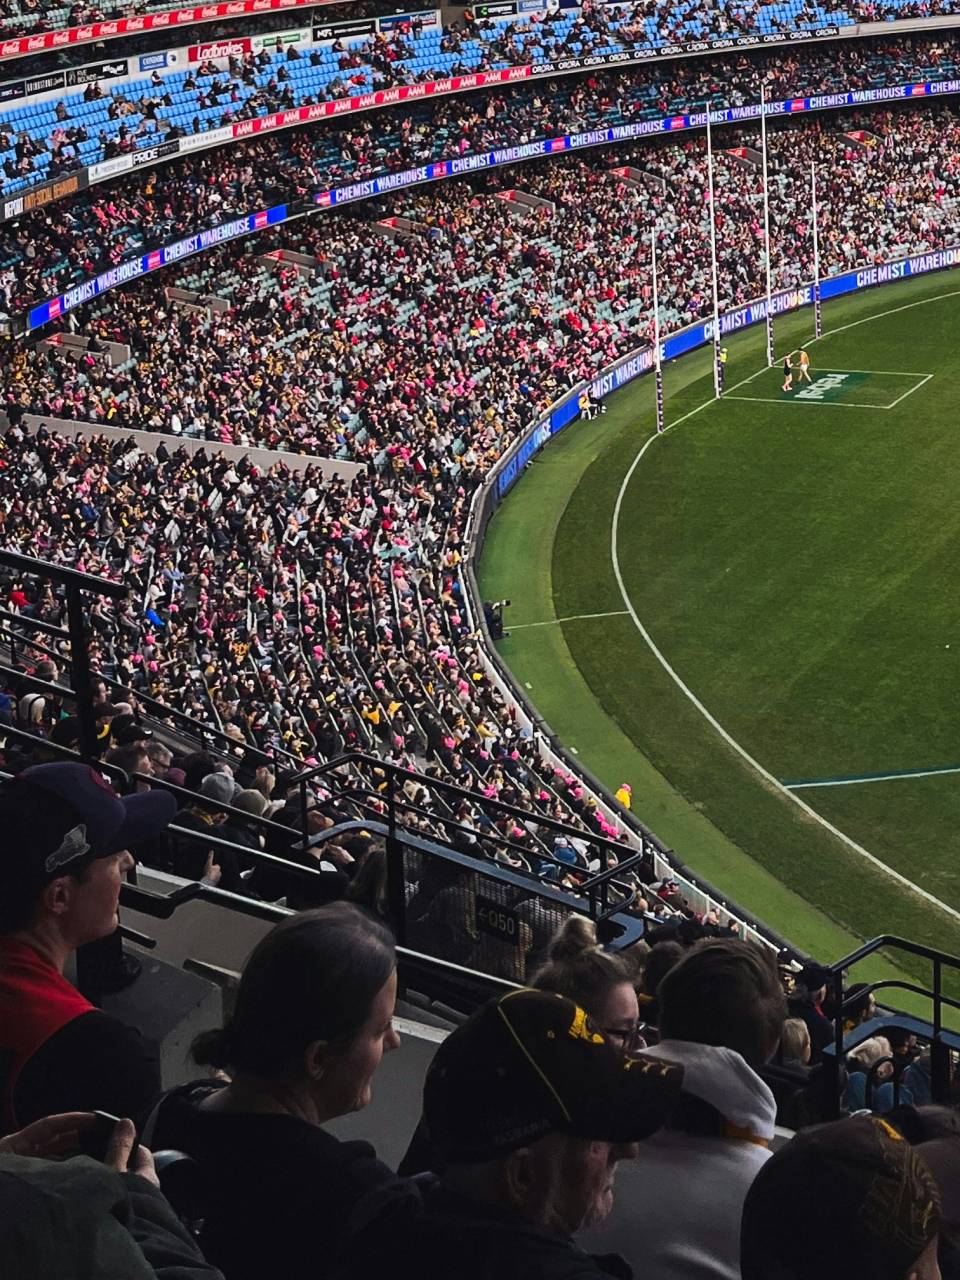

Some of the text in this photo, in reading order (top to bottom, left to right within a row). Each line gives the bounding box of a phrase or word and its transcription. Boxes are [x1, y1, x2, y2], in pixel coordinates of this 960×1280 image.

[197, 41, 243, 61] Ladbrokes
[133, 148, 158, 165] PRIDE
[336, 180, 374, 202] CHEMIST
[377, 167, 426, 190] WAREHOUSE
[452, 152, 490, 173] CHEMIST
[495, 141, 544, 163] WAREHOUSE
[570, 129, 608, 147] CHEMIST
[612, 119, 664, 139] WAREHOUSE
[810, 93, 848, 108] CHEMIST
[852, 86, 905, 102] WAREHOUSE
[64, 216, 250, 310] CHEMIST WAREHOUSE CHEMIST WAREHOUSE
[856, 262, 905, 288] CHEMIST
[488, 910, 515, 935] Q50
